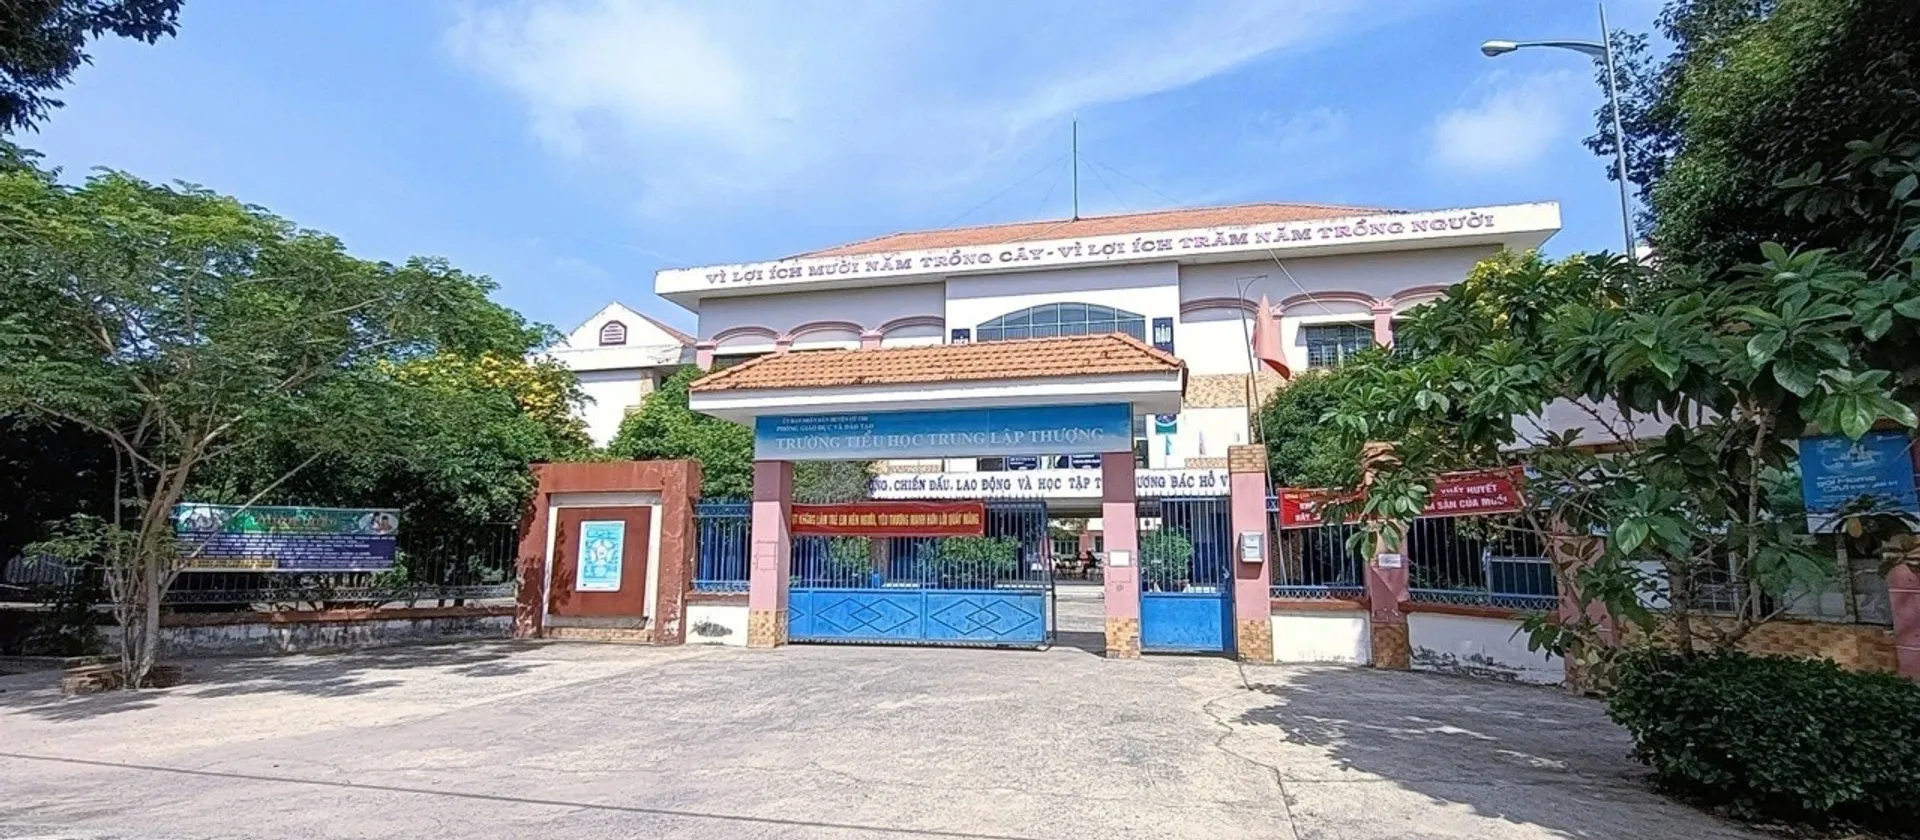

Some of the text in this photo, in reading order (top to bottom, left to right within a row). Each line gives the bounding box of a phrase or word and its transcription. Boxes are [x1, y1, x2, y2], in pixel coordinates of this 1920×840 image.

[705, 269, 726, 284] VÌ
[732, 269, 764, 285] LỢI
[768, 265, 803, 280] ÍCH
[808, 260, 859, 277] MƯỜI
[866, 254, 912, 273] NĂM
[999, 246, 1045, 262] CÂY
[1058, 241, 1082, 258] VÌ
[1088, 241, 1126, 260] LỢI
[1132, 237, 1173, 253] ÍCH
[1178, 230, 1249, 249] TRĂM
[1255, 226, 1312, 244] NĂM
[1411, 211, 1495, 233] NGƯỜI
[776, 426, 1104, 449] TRƯỜNG TIỂU HỌC TRUNG LẬP THƯỢNG
[893, 474, 927, 491] CHIẾN
[956, 479, 978, 491] LAO
[981, 478, 1011, 493] ĐỘNG
[1017, 475, 1032, 490] VÀ
[1038, 477, 1062, 492] HỌC
[1068, 475, 1091, 491] TẬP
[1136, 475, 1165, 488] ƯƠNG
[1170, 472, 1195, 488] BÁC
[1199, 469, 1215, 488] HỒ
[1459, 496, 1479, 508] CỦA
